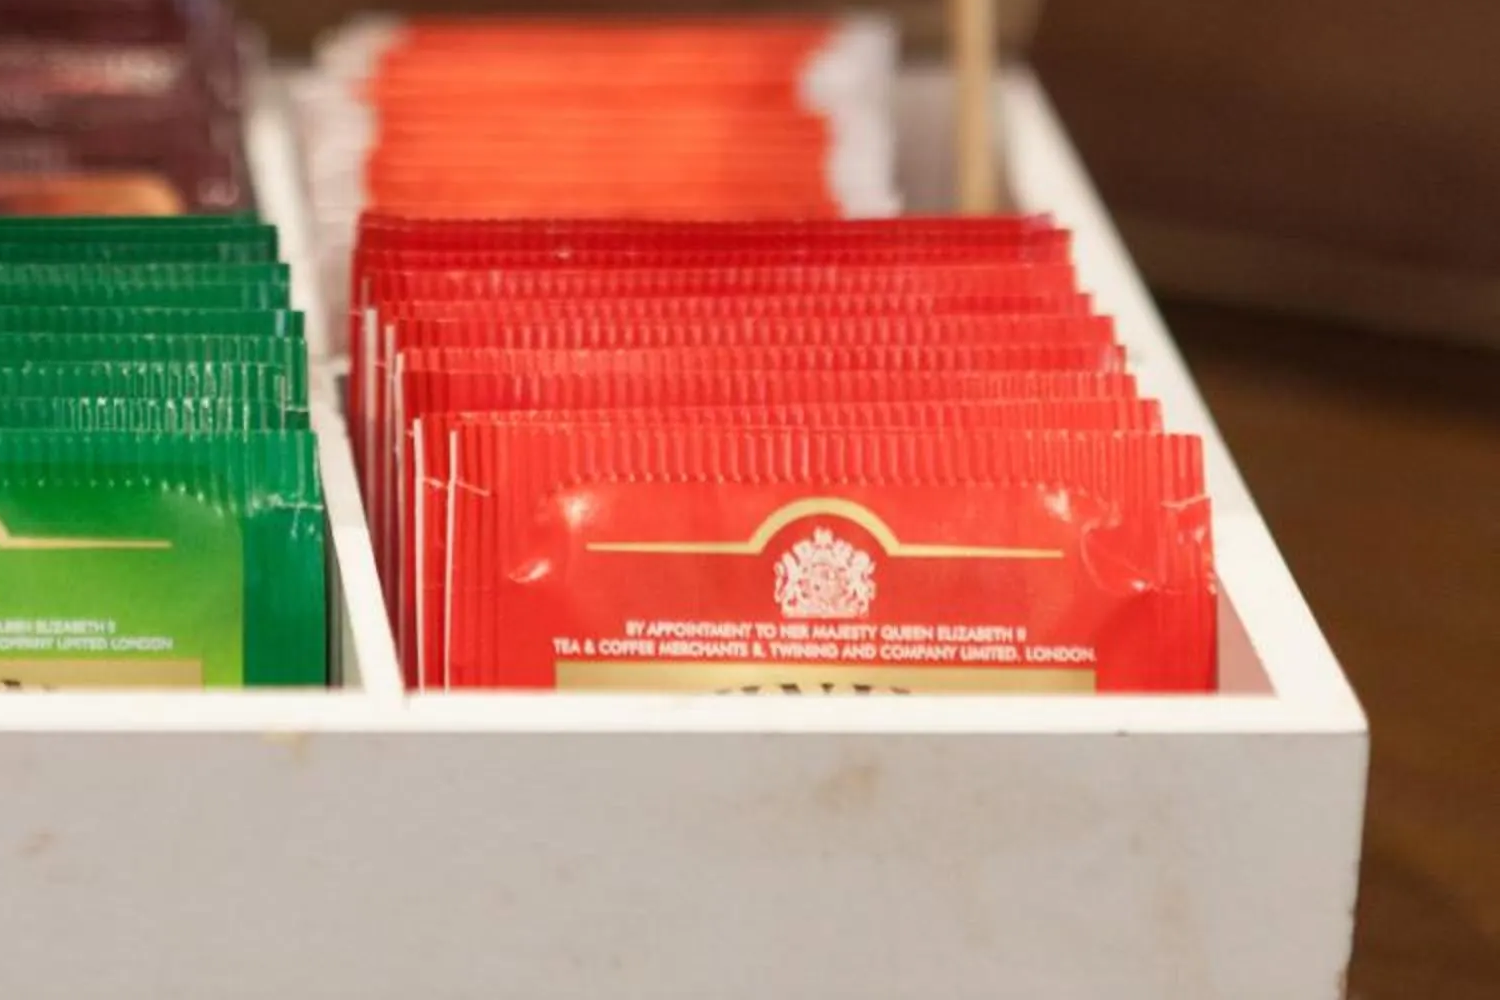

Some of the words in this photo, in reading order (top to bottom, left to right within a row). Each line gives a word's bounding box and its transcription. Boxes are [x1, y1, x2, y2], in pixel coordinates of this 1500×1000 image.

[626, 620, 645, 636] BY
[647, 621, 752, 637] APPOINTMENT
[755, 622, 776, 638] TO
[781, 623, 809, 639] HER
[813, 624, 877, 640] MAJESTY
[880, 625, 933, 641] QUEEN
[937, 625, 1013, 642] ELIZABETH
[553, 638, 580, 654] TEA
[584, 639, 595, 655] &
[599, 639, 655, 656] COFFEE
[659, 640, 748, 657] MERCHANTS
[770, 642, 838, 659] TWINING
[842, 643, 877, 660] AND
[880, 644, 958, 660] COMPANY
